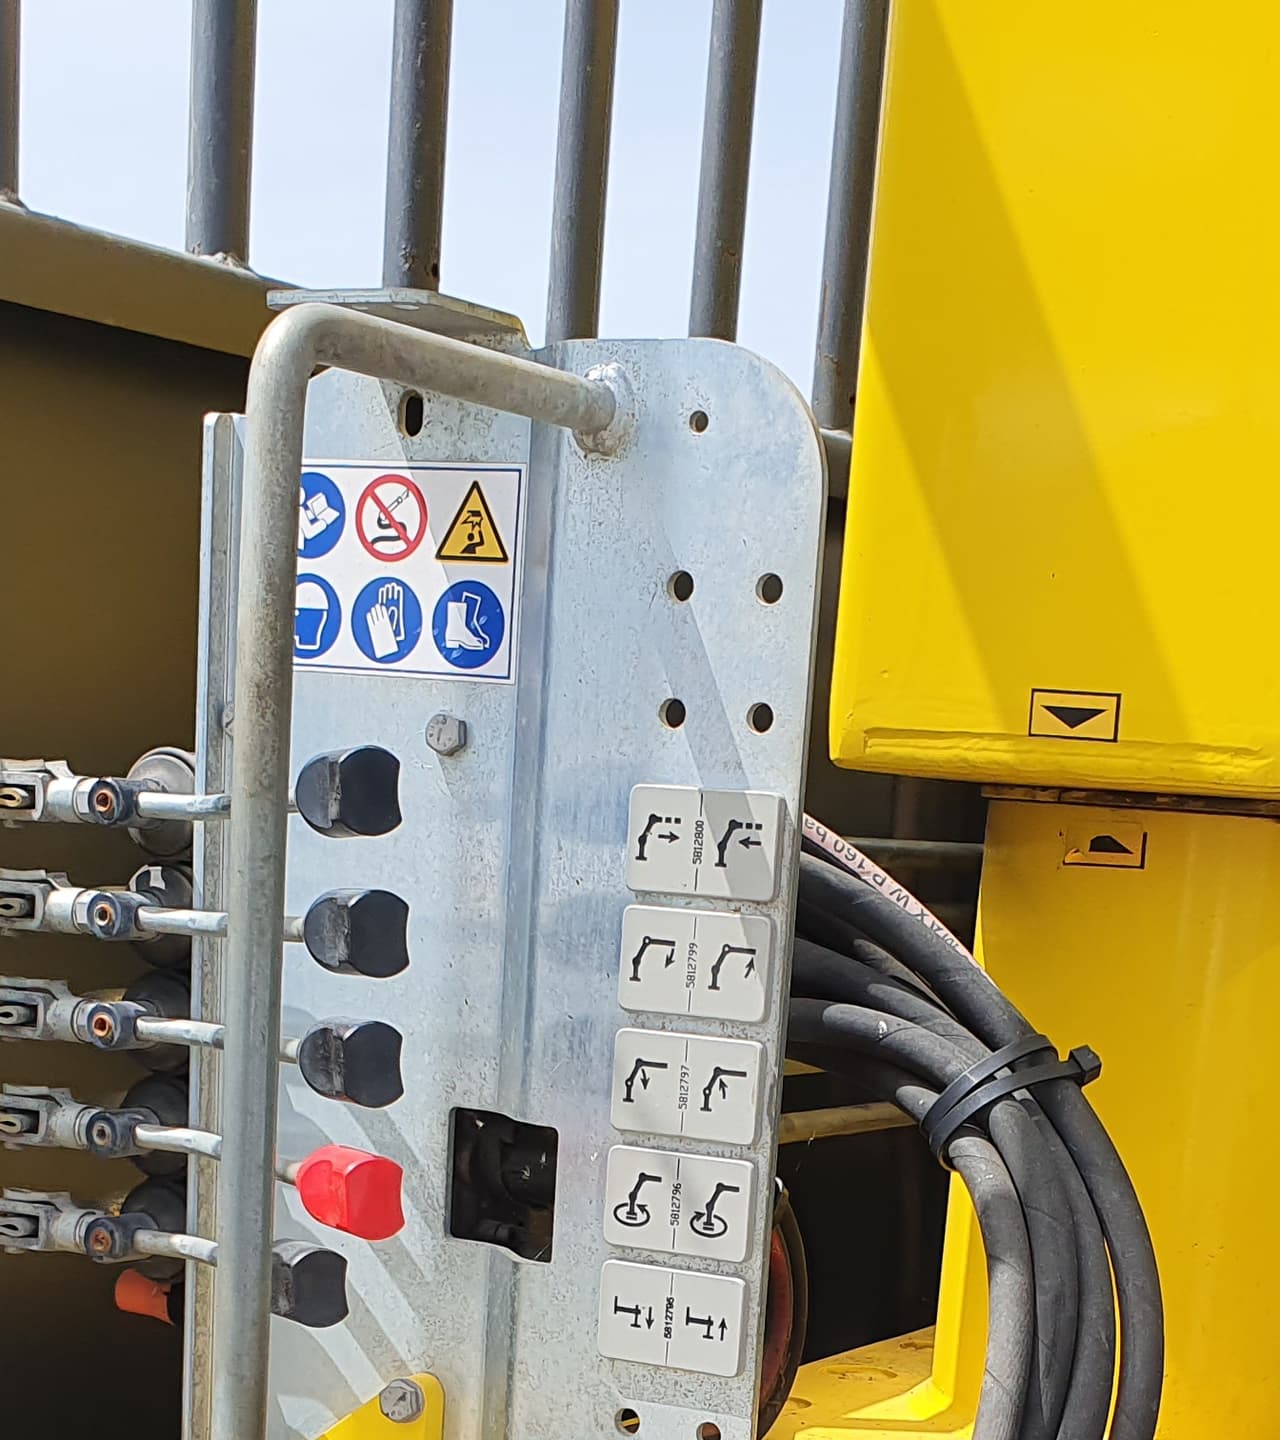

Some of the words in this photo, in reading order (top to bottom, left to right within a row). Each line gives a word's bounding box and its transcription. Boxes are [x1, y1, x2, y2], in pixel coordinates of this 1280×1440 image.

[692, 820, 705, 865] 5812800
[833, 839, 866, 870] 160
[686, 942, 699, 989] 5812799
[678, 1065, 690, 1111] 5812797
[670, 1182, 682, 1227] 5812796
